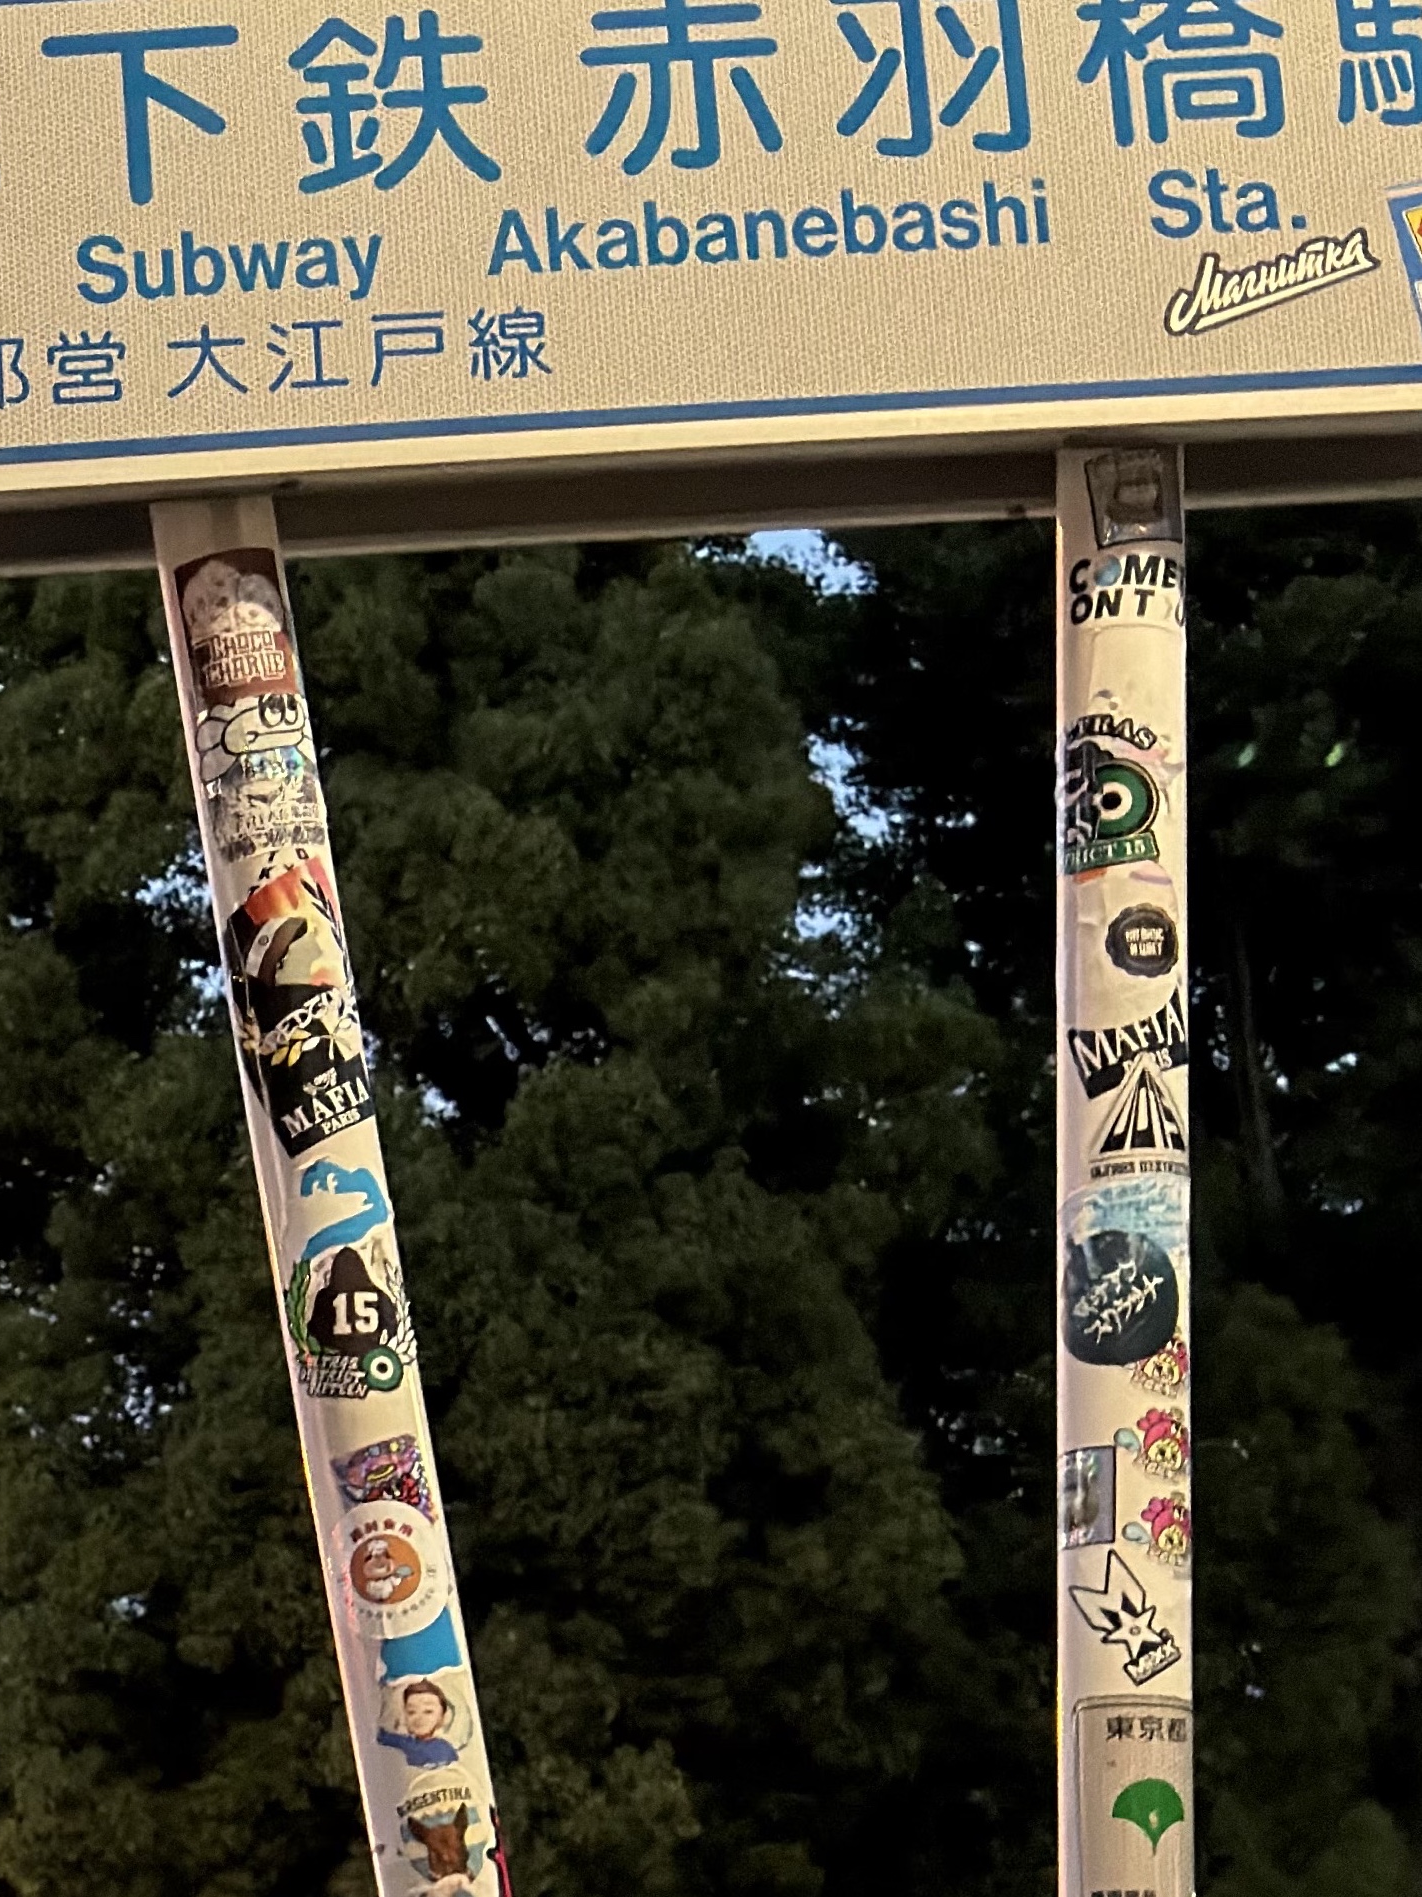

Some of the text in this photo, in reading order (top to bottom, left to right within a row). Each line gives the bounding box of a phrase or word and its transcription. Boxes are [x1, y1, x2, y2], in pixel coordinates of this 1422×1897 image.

[76, 167, 1308, 304] Subway Akabanebashi Sta.
[1074, 1000, 1185, 1080] MAFIA
[280, 1076, 370, 1139] MAFIA
[321, 1107, 362, 1136] PARIS
[332, 1291, 379, 1335] 15
